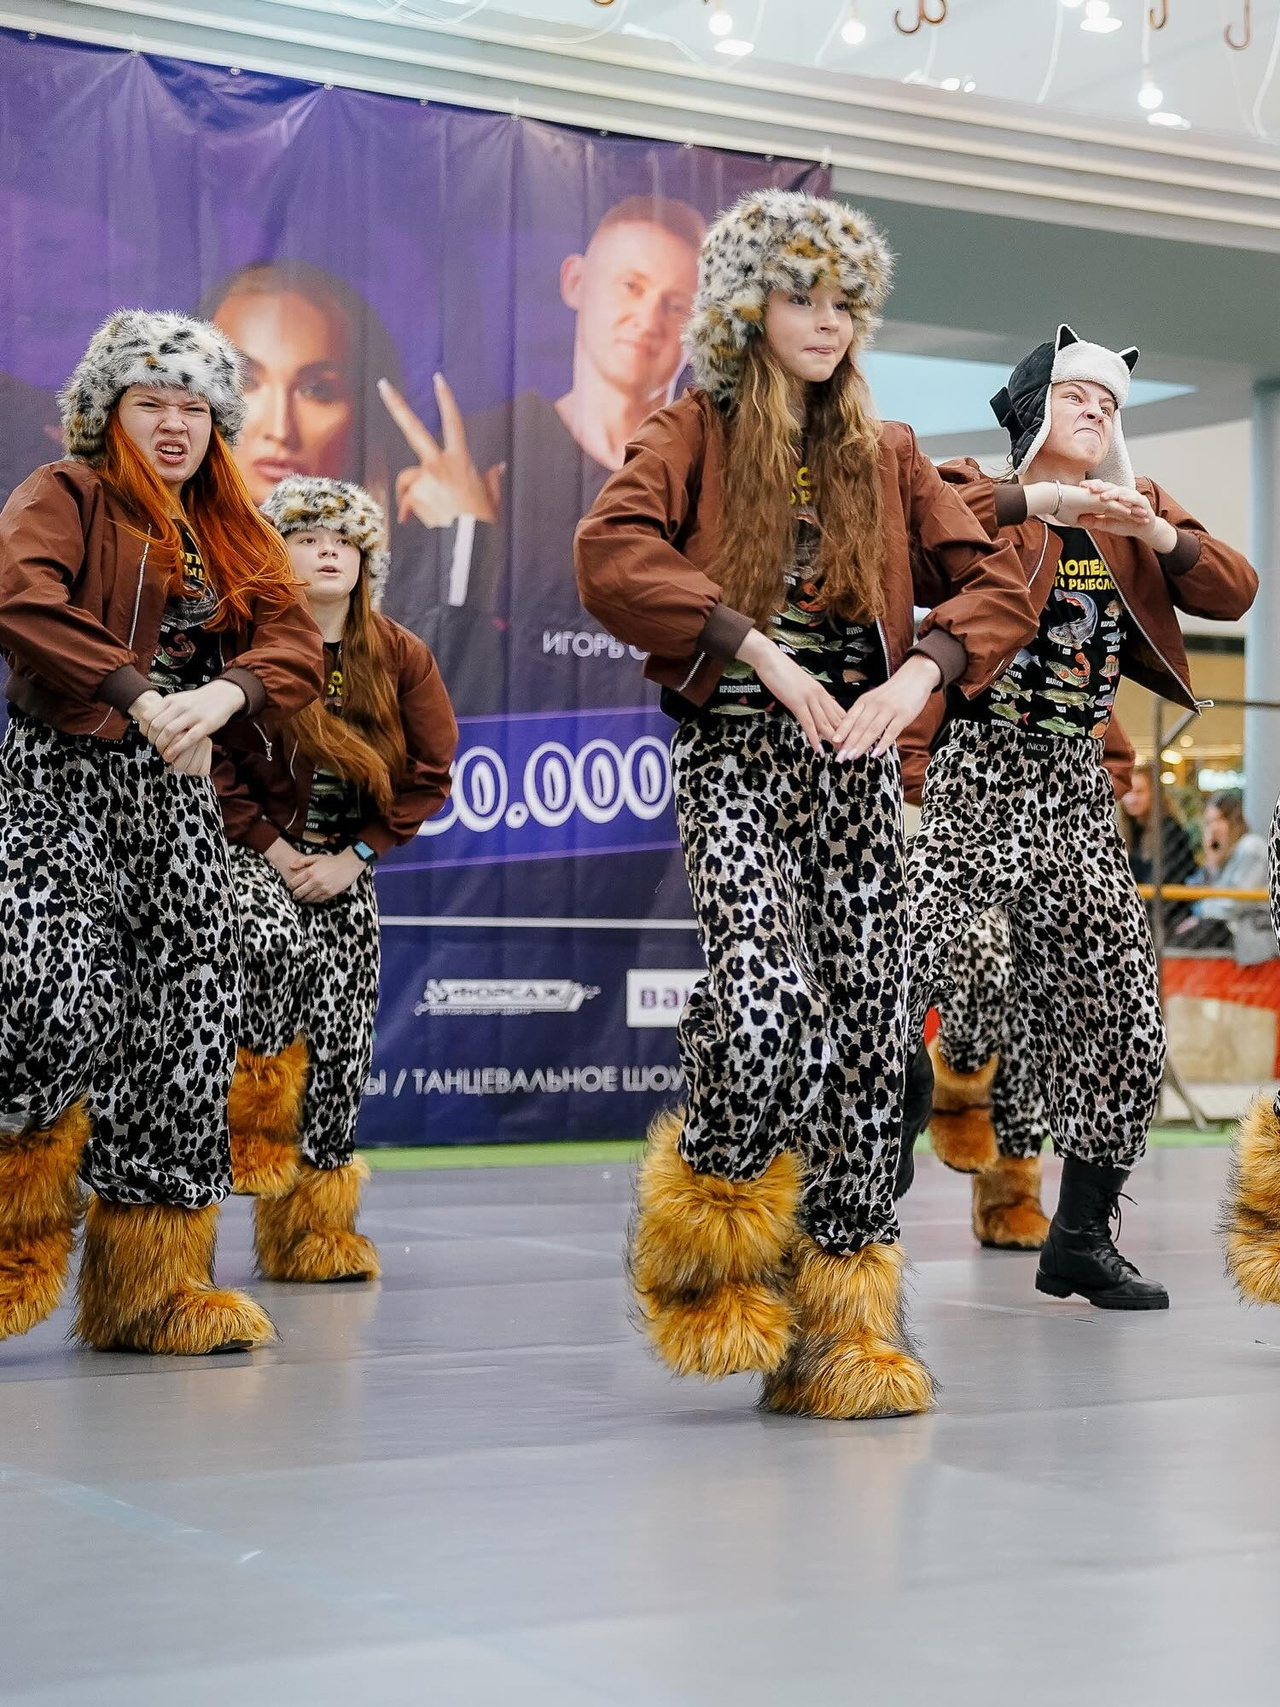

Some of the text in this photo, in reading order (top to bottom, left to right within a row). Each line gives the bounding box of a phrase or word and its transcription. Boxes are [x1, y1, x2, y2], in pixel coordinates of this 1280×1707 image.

[542, 630, 624, 659] ИГОРЬ
[1026, 742, 1049, 753] INICIO
[416, 735, 674, 836] 0.000
[411, 1065, 619, 1097] ТАНЦЕВАЛЬНОЕ
[622, 1065, 685, 1092] ШОУ
